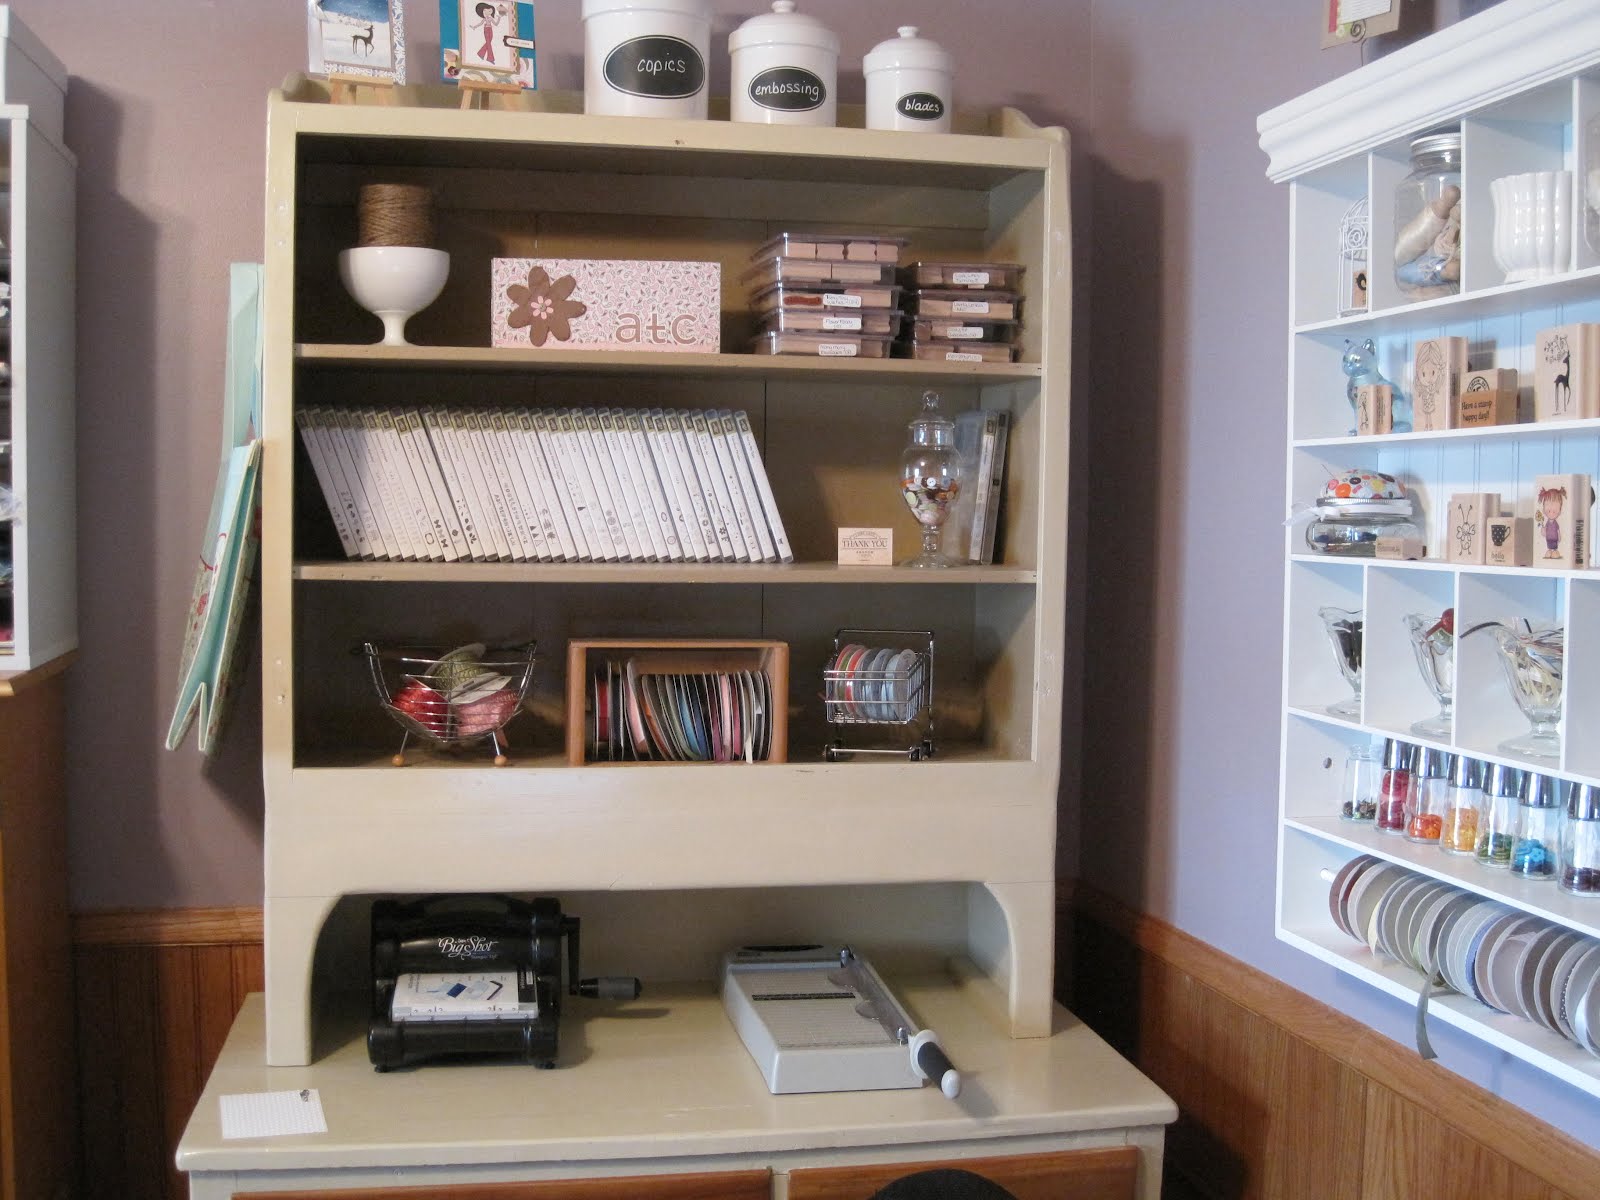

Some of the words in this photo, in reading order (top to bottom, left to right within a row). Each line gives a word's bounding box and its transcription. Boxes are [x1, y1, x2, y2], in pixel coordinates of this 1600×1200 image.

[637, 52, 686, 75] copics
[755, 81, 820, 101] embossing
[905, 98, 940, 112] blades
[615, 312, 698, 345] atc
[842, 540, 870, 548] THANK
[871, 540, 888, 548] YOU
[438, 936, 465, 958] Big
[461, 935, 499, 960] Shot
